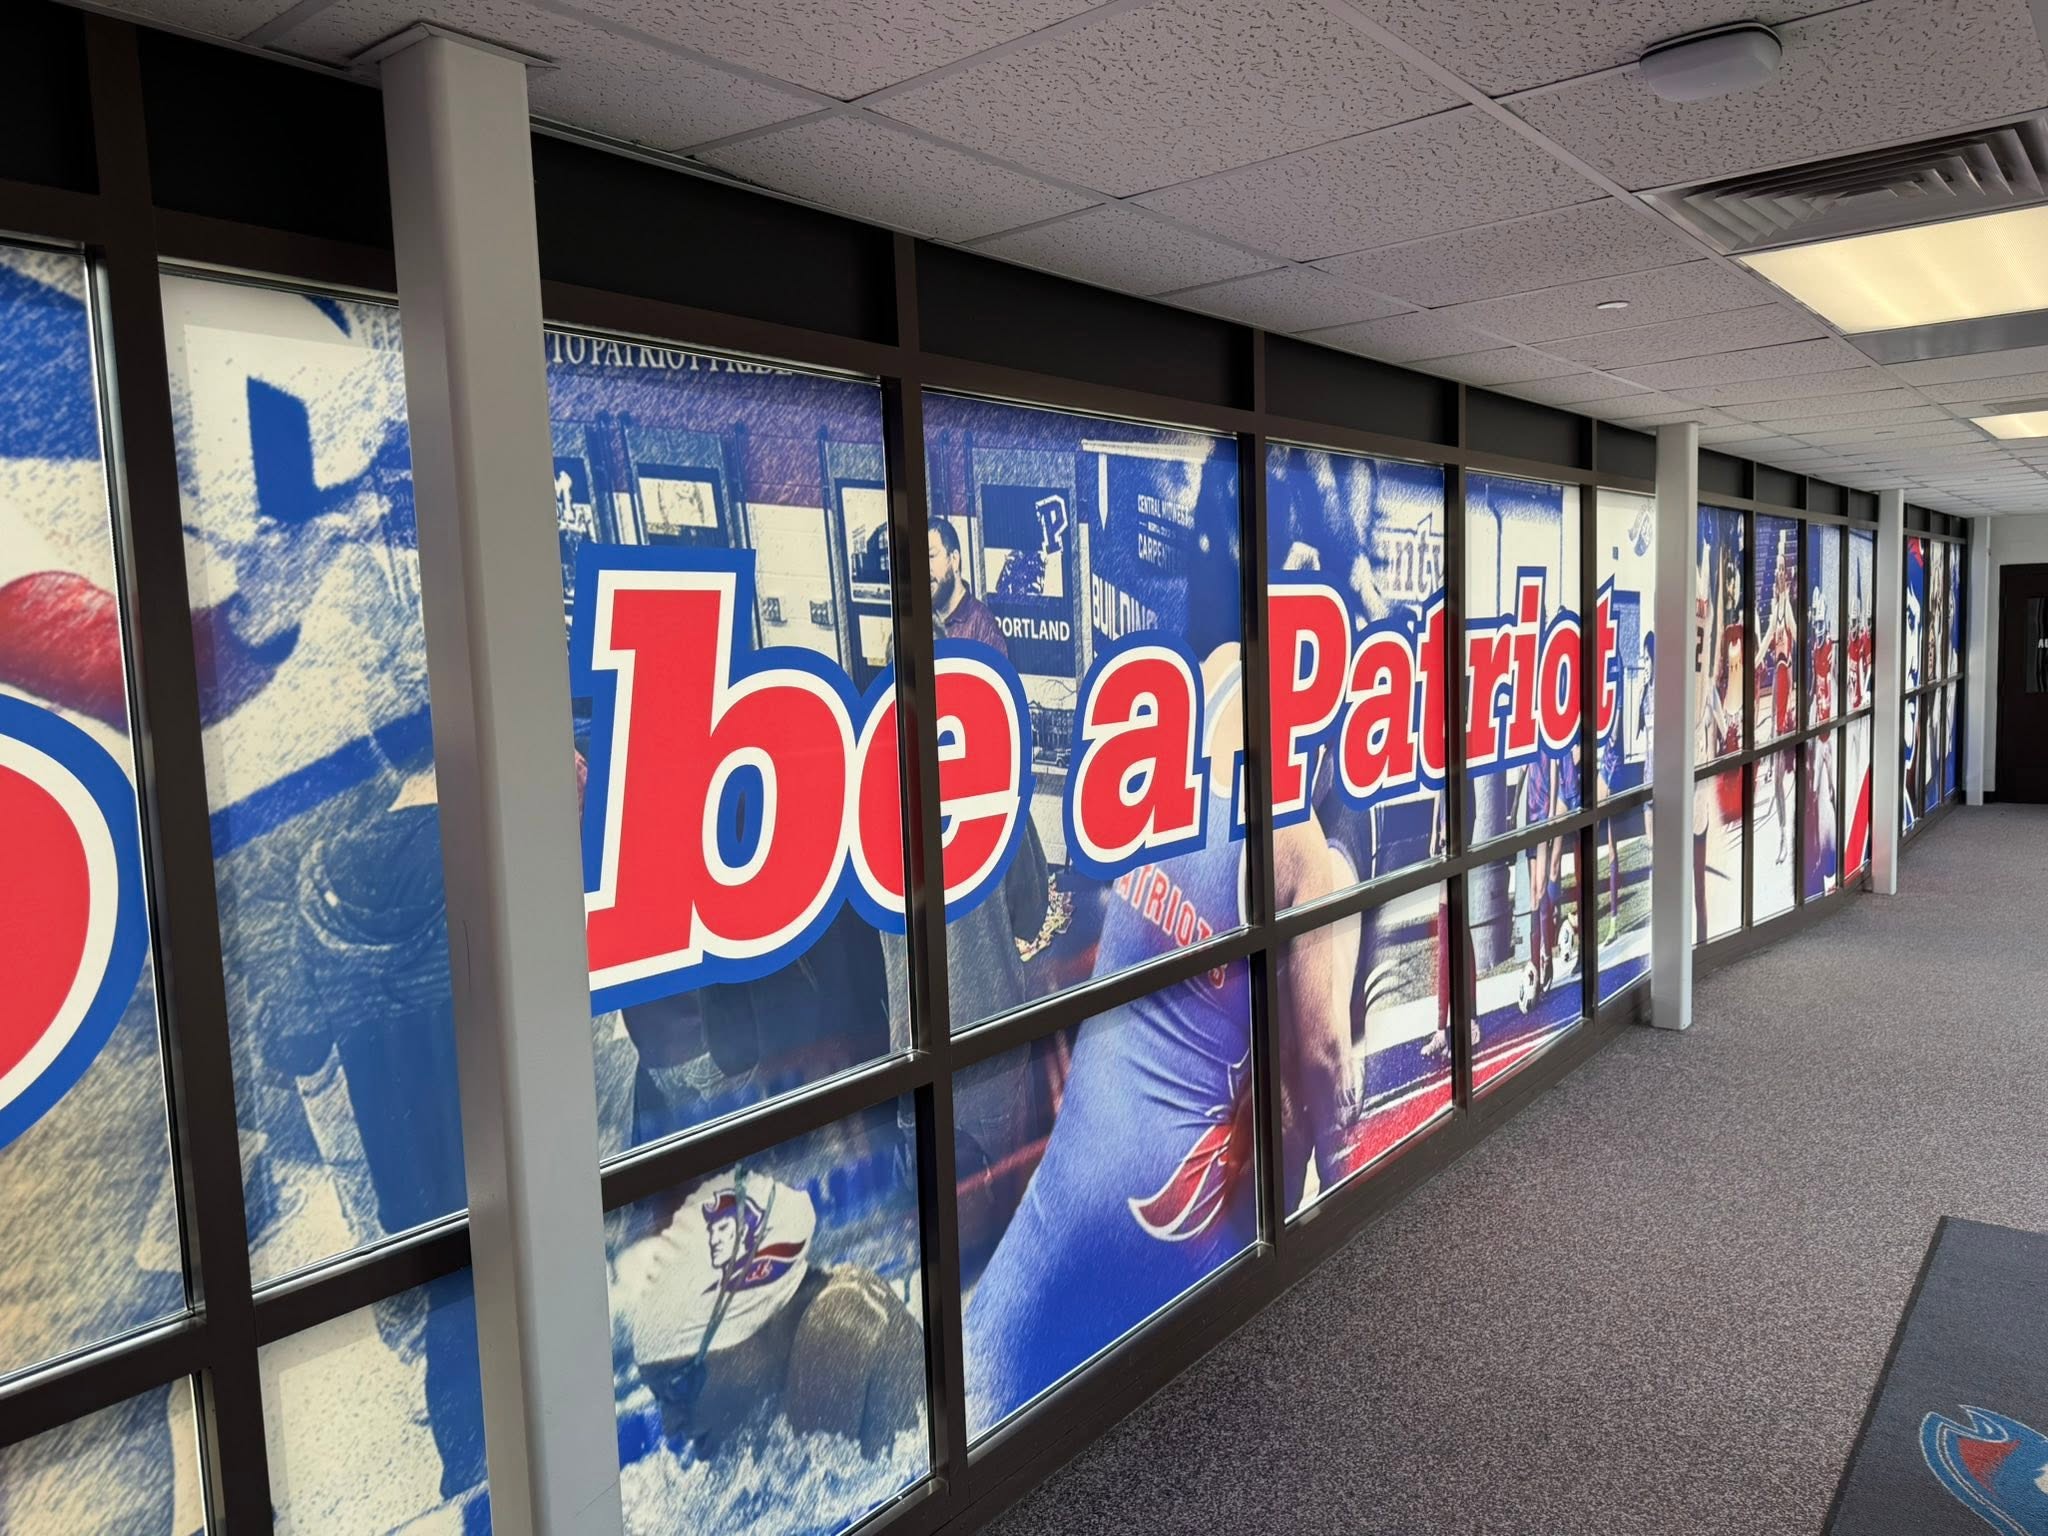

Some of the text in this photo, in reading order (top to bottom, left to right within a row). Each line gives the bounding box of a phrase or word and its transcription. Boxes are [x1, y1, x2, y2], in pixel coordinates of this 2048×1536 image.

[582, 568, 1620, 992] be a Patriot
